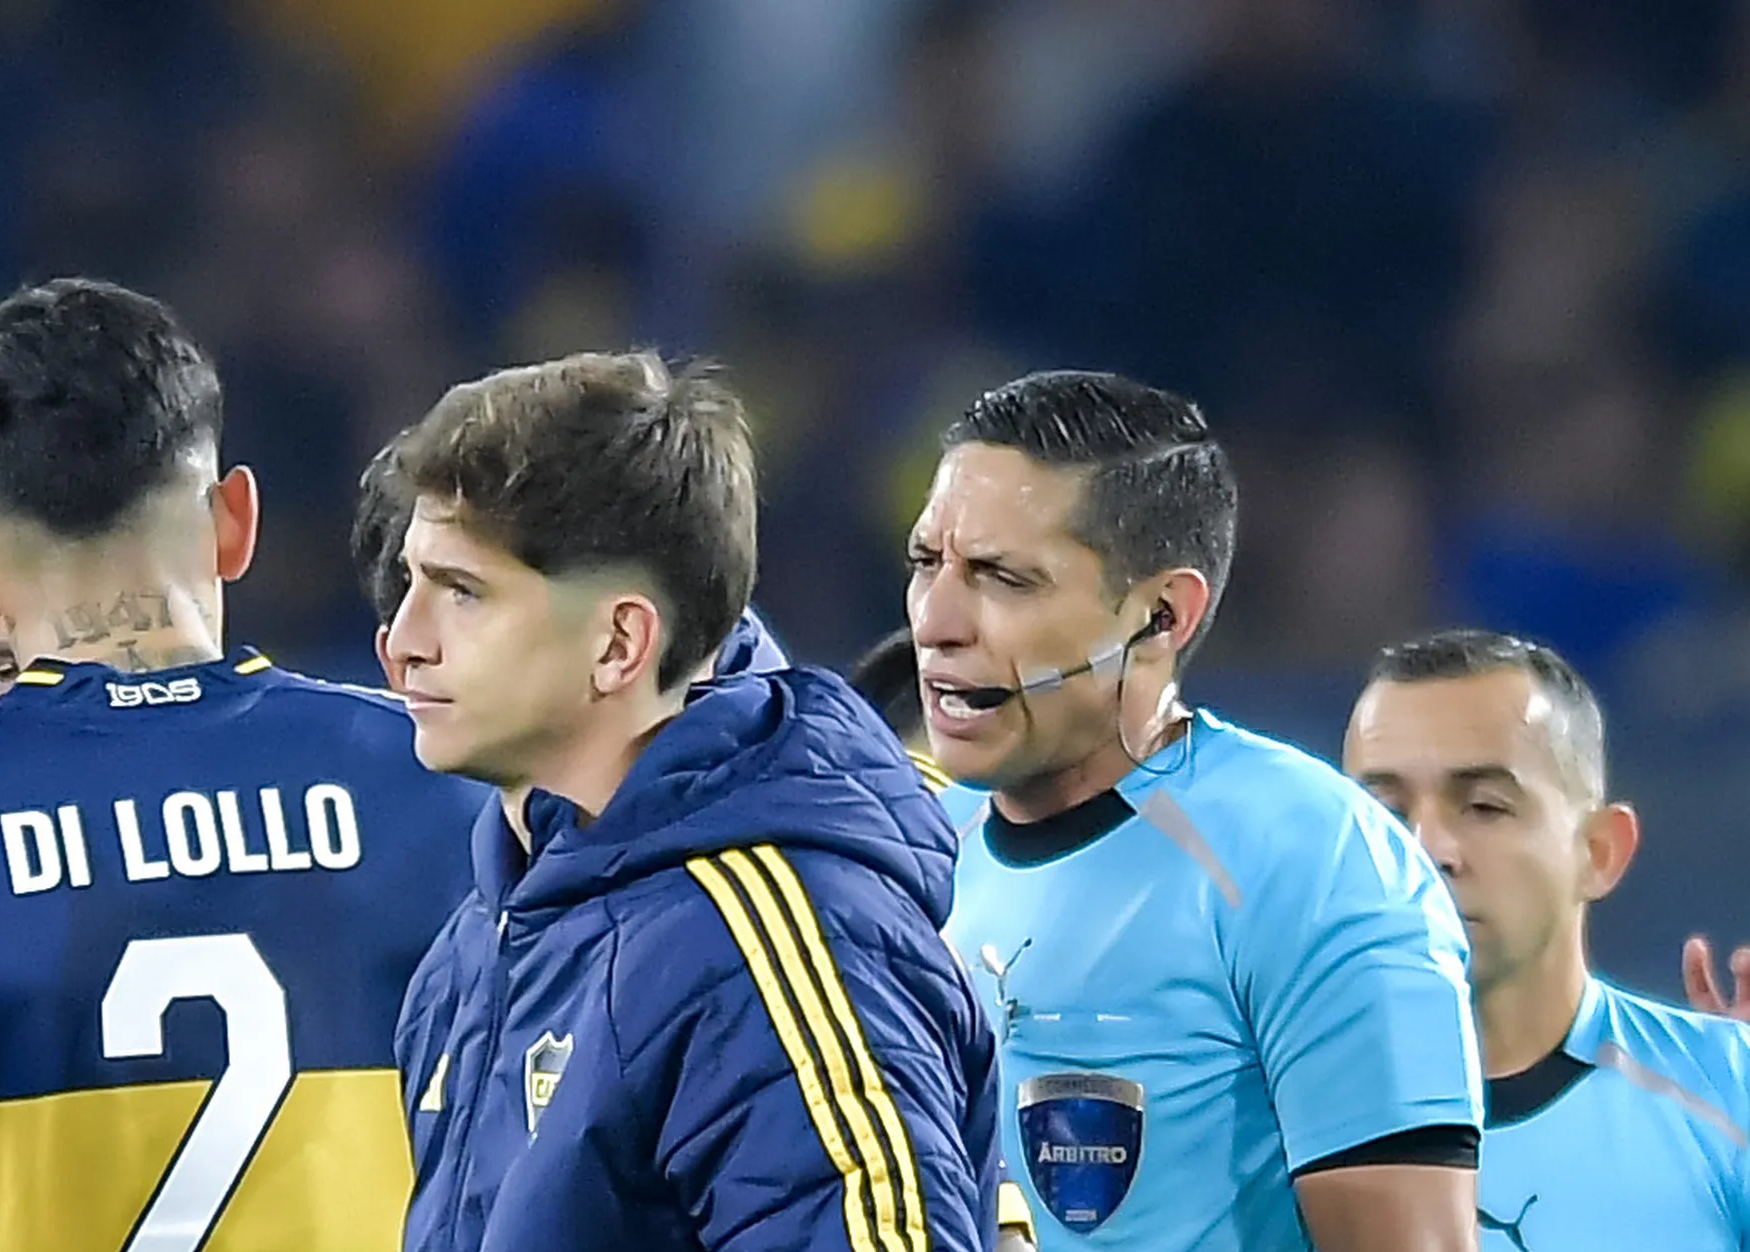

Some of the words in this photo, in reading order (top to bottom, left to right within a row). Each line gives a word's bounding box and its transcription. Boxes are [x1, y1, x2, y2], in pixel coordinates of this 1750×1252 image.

[105, 677, 202, 707] 1905
[0, 804, 92, 895] DI
[113, 783, 362, 882] LOLLO
